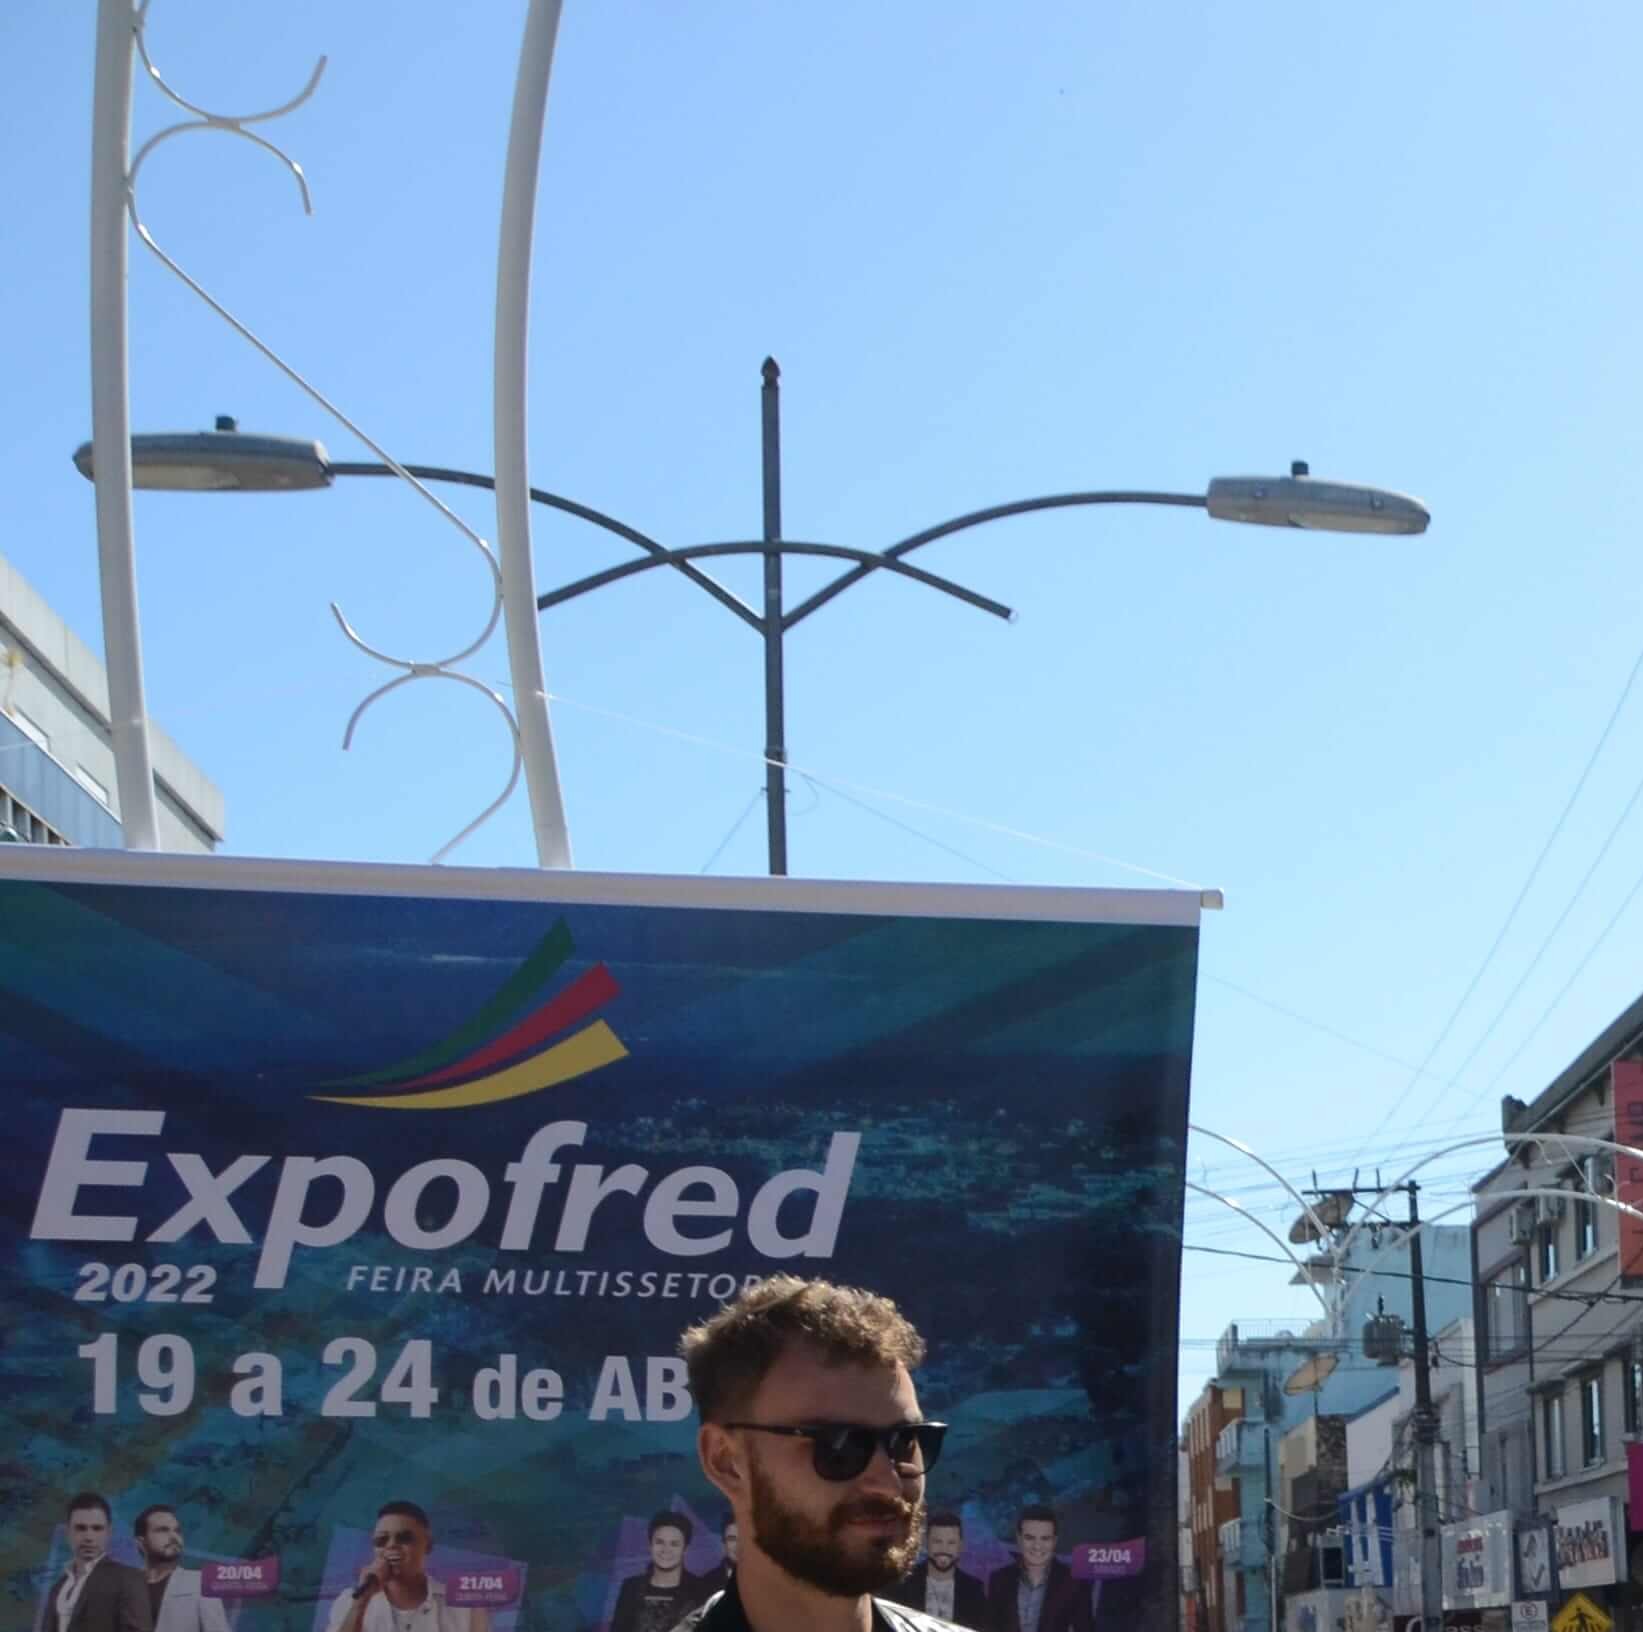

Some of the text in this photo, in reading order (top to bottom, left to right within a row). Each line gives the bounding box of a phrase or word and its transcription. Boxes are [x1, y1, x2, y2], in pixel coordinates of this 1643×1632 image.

[29, 1107, 862, 1290] Expofred
[73, 1263, 216, 1304] 2022
[346, 1265, 463, 1294] FEIRA
[78, 1332, 196, 1417] 19
[230, 1352, 283, 1418] a
[321, 1337, 438, 1419] 24
[472, 1354, 563, 1421] de
[1088, 1549, 1131, 1563] 23/04
[217, 1566, 262, 1579] 20/04
[460, 1576, 503, 1590] 21/04
